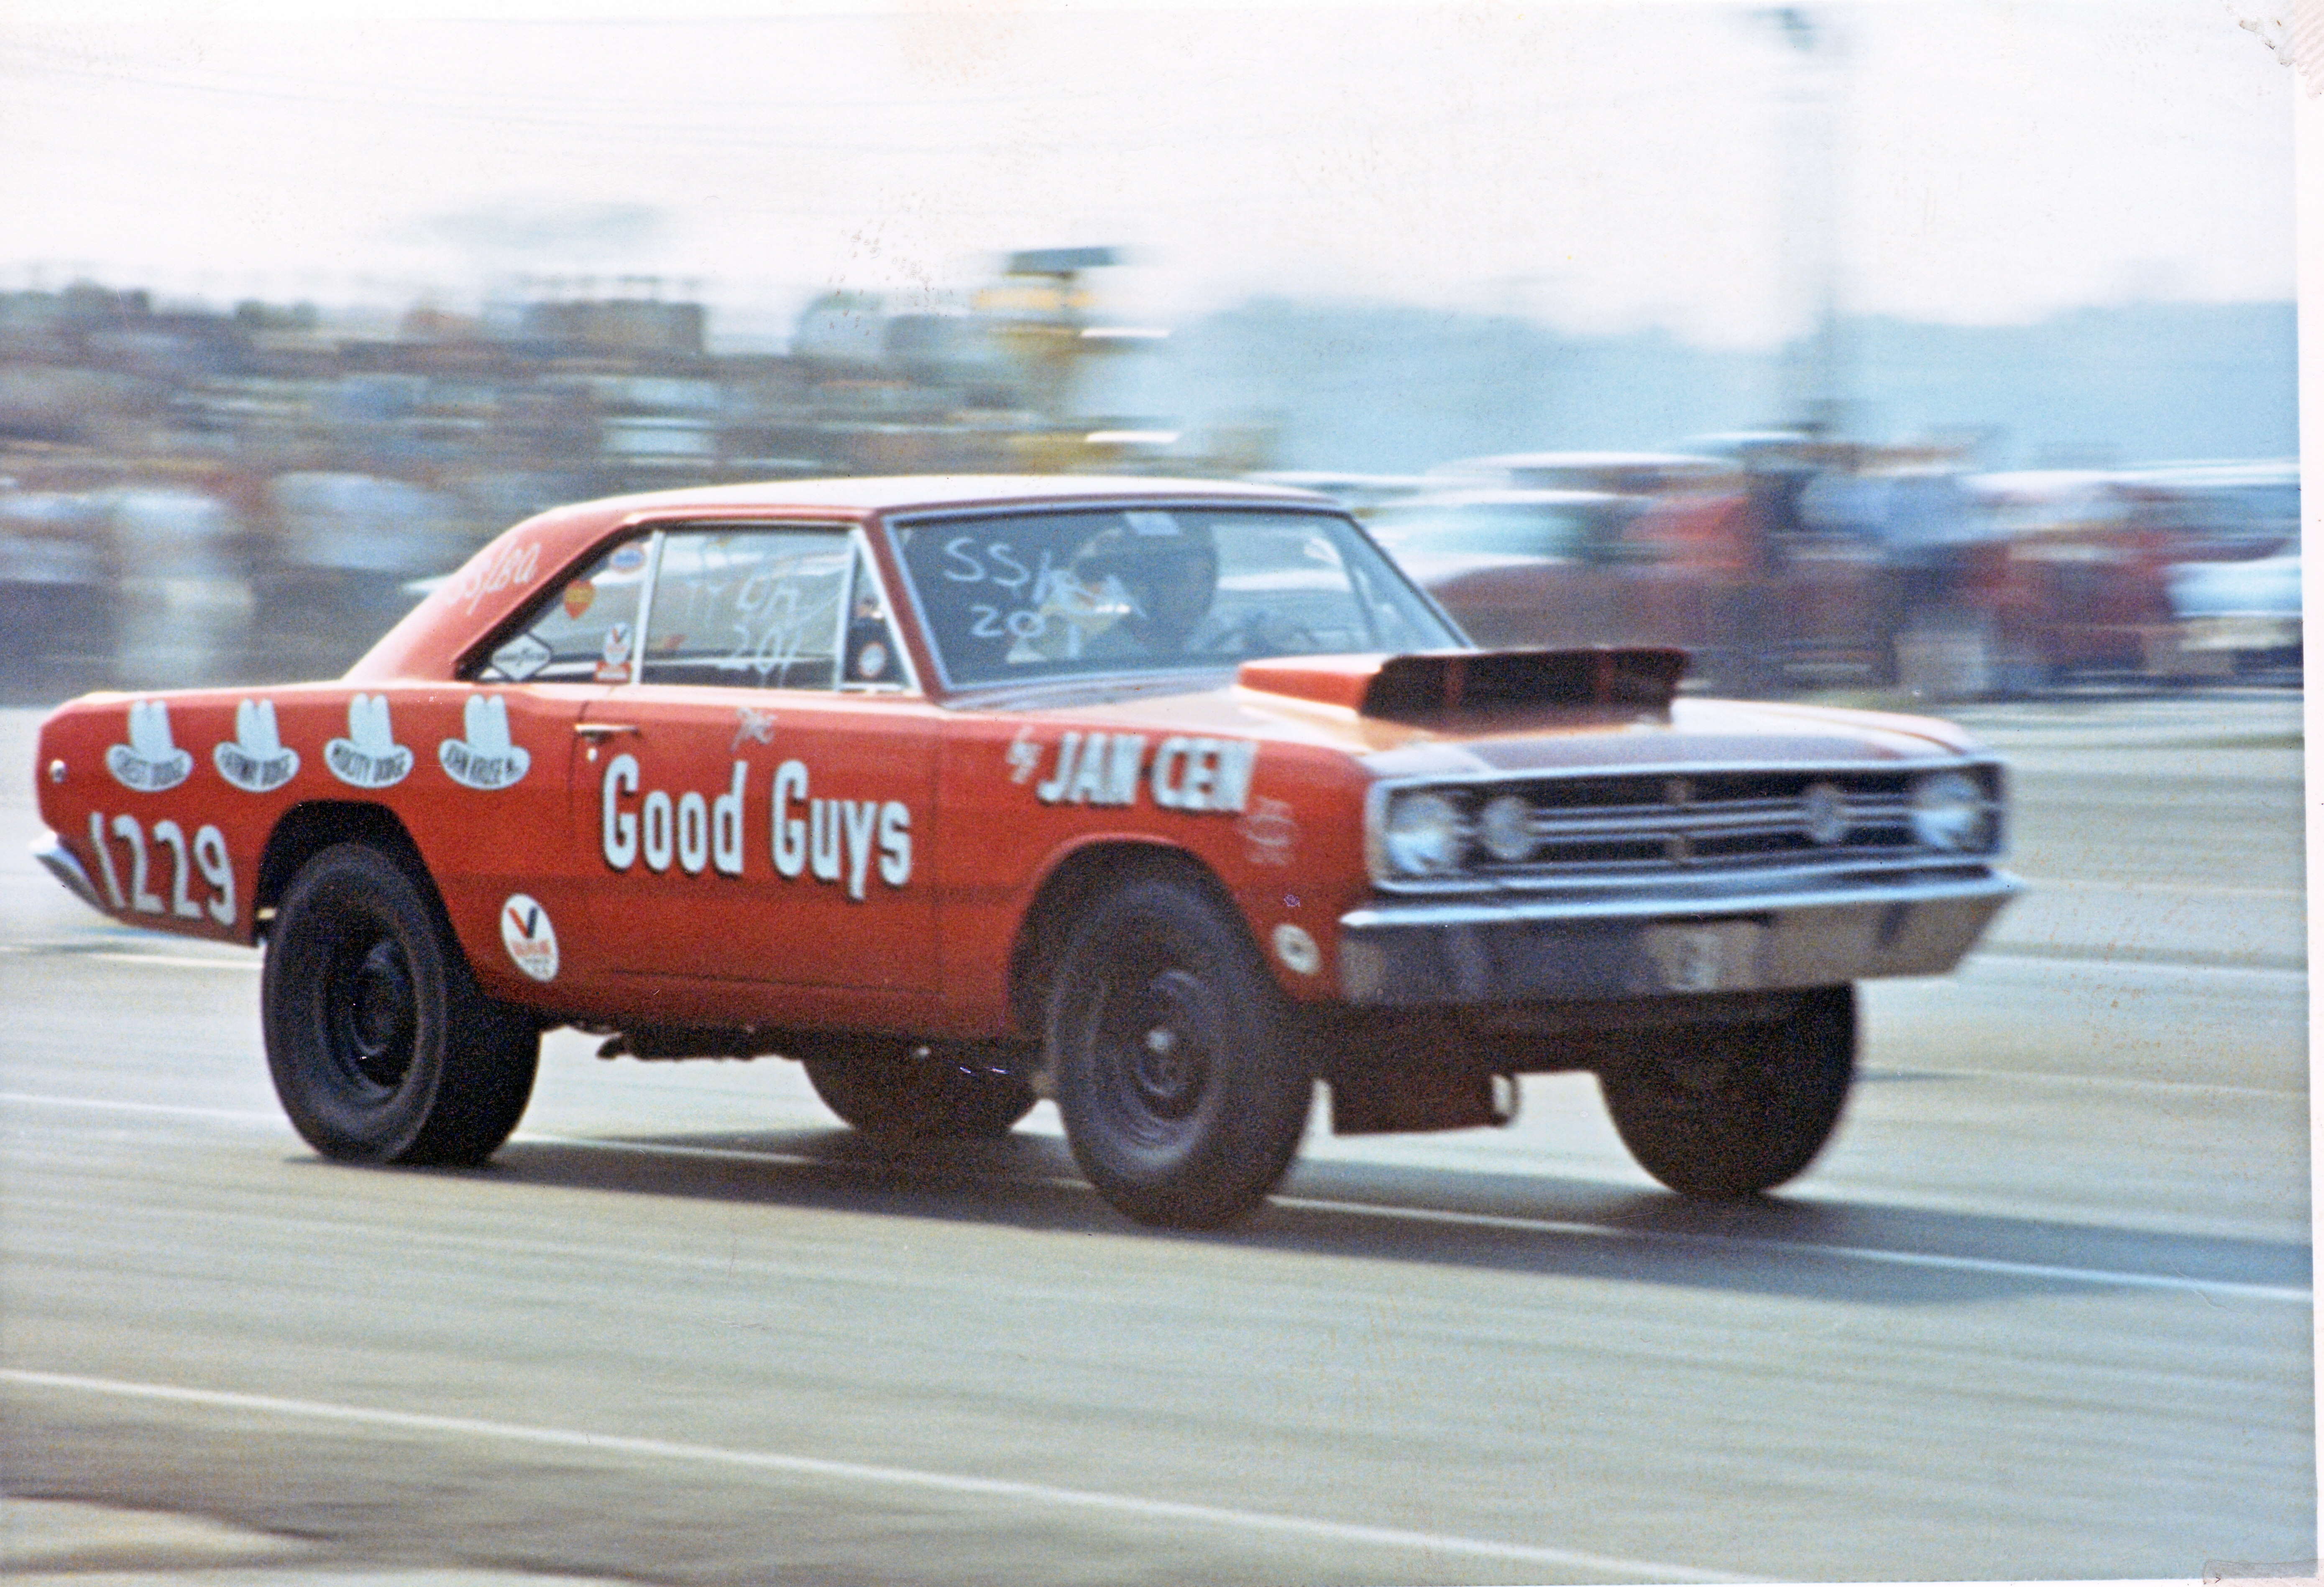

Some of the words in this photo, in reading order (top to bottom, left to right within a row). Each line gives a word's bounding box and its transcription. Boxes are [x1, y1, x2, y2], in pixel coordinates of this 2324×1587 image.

[89, 812, 236, 925] 1229
[602, 754, 748, 875] Good
[771, 760, 912, 901] Guys
